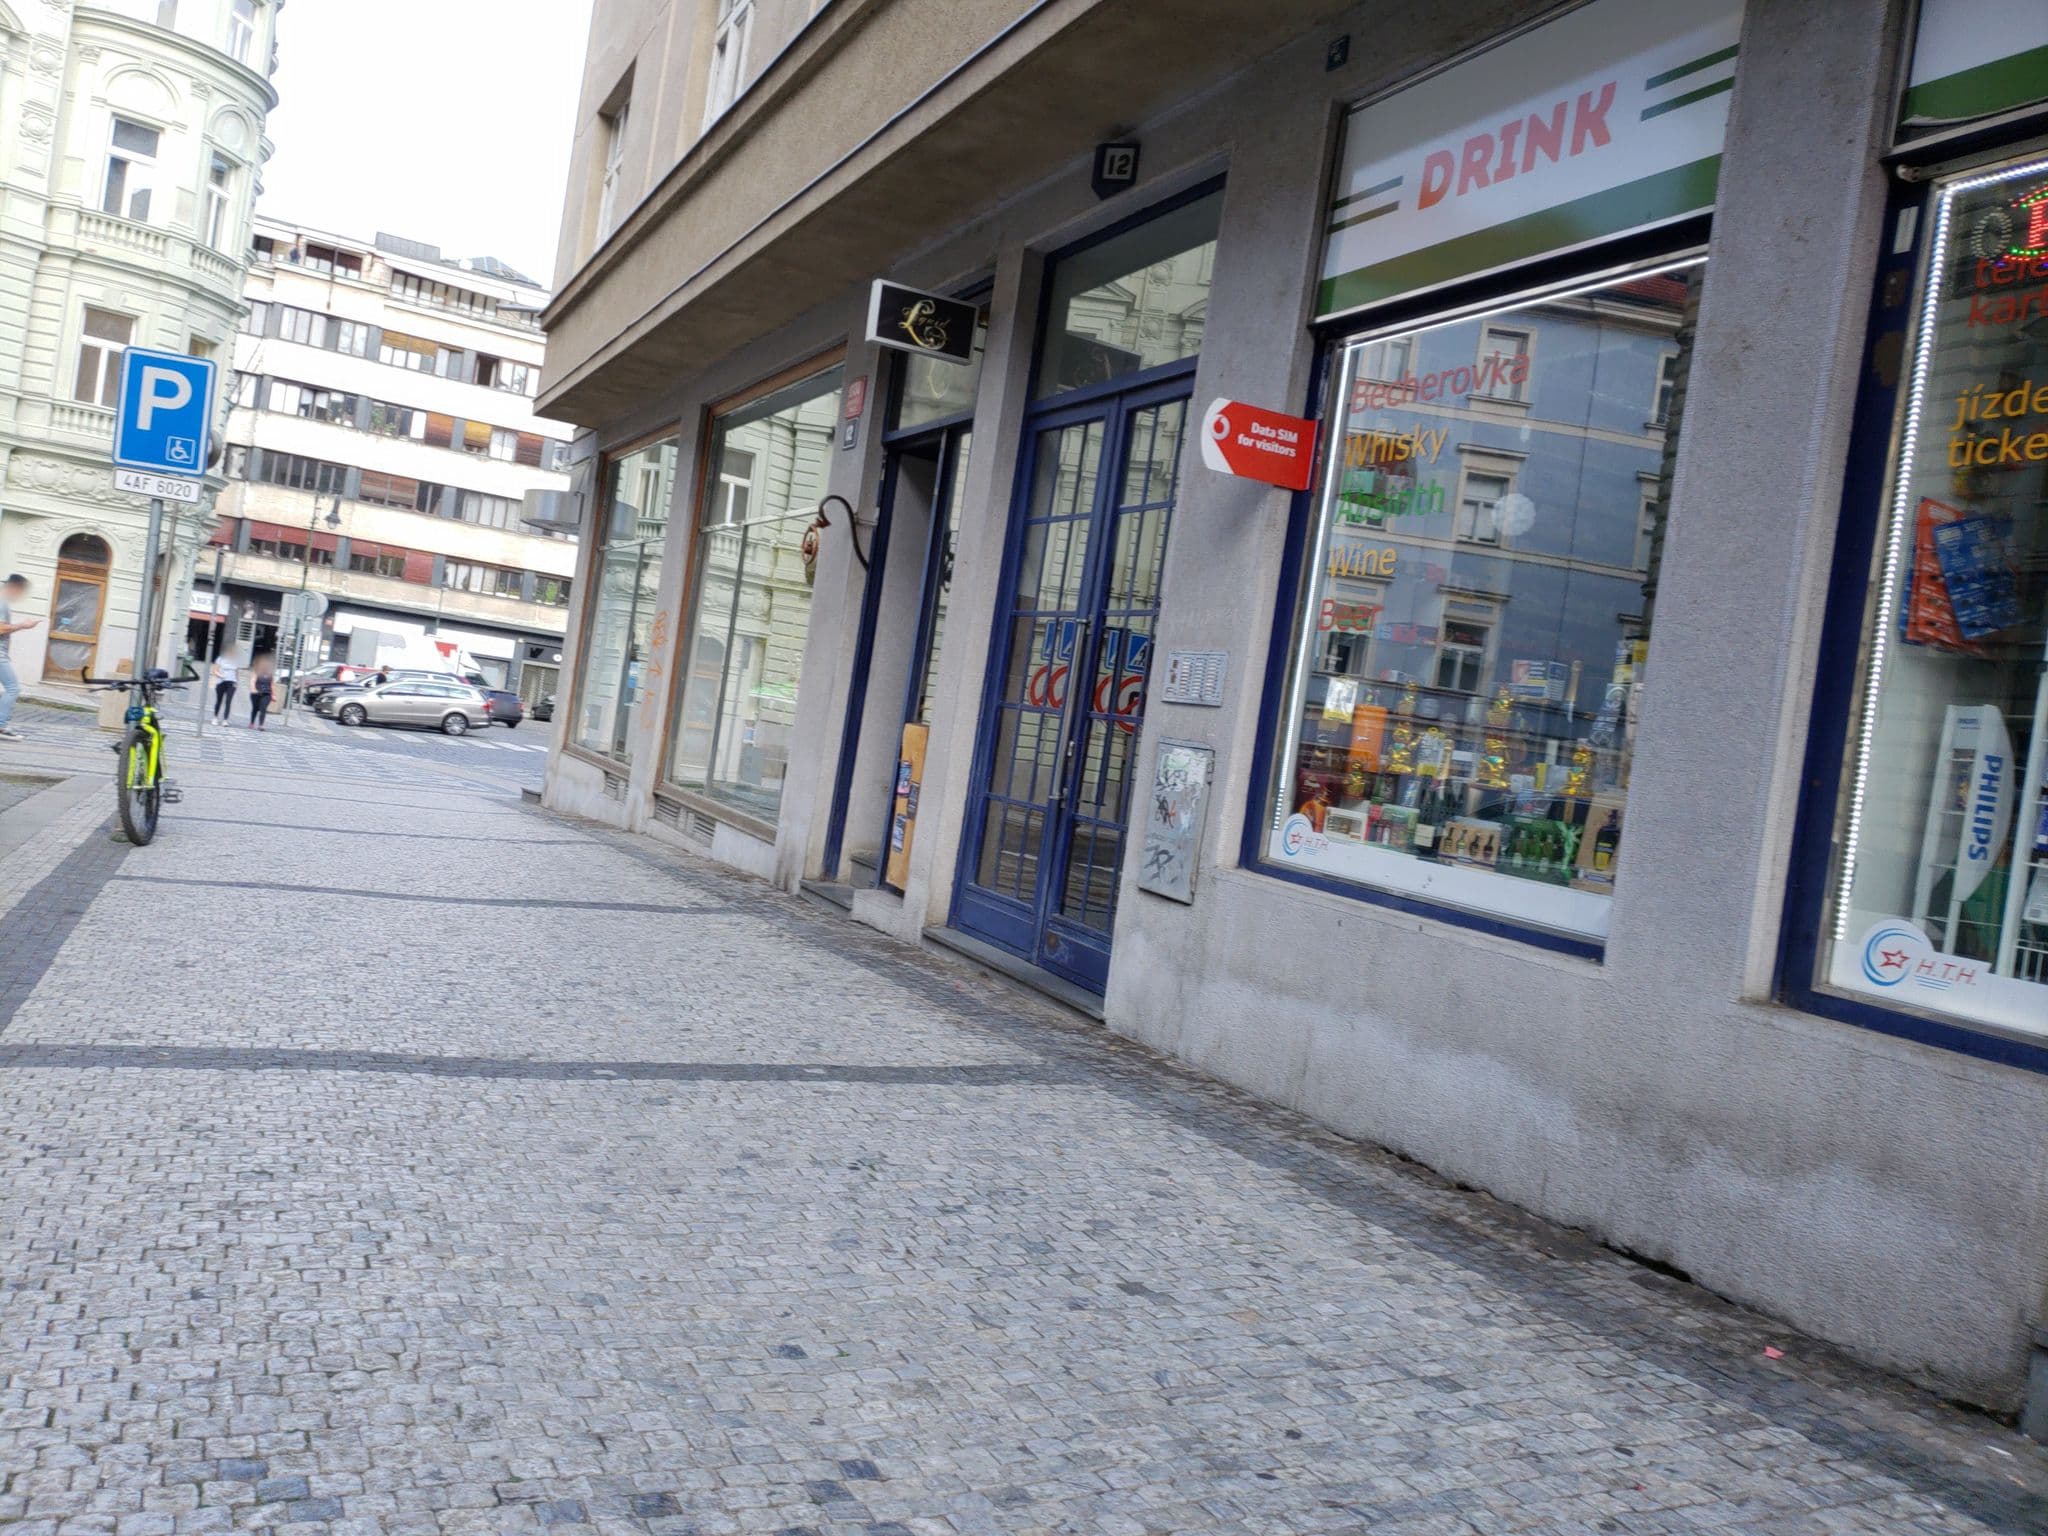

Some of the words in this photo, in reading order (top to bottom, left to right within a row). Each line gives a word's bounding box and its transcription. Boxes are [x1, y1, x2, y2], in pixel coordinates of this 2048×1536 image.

[1418, 81, 1617, 210] DRINK
[1108, 154, 1131, 175] 12
[136, 365, 192, 431] P
[1351, 351, 1530, 414] Becherovka
[1237, 433, 1255, 447] for
[1255, 440, 1297, 457] visitors
[1251, 421, 1276, 438] Data
[1277, 428, 1298, 444] SIM
[1345, 423, 1449, 466] Whisky
[123, 474, 151, 491] 4AF
[156, 480, 192, 498] 6020
[1329, 543, 1397, 577] Wine
[1319, 598, 1384, 631] Beer
[1967, 754, 2004, 861] PHILIPS
